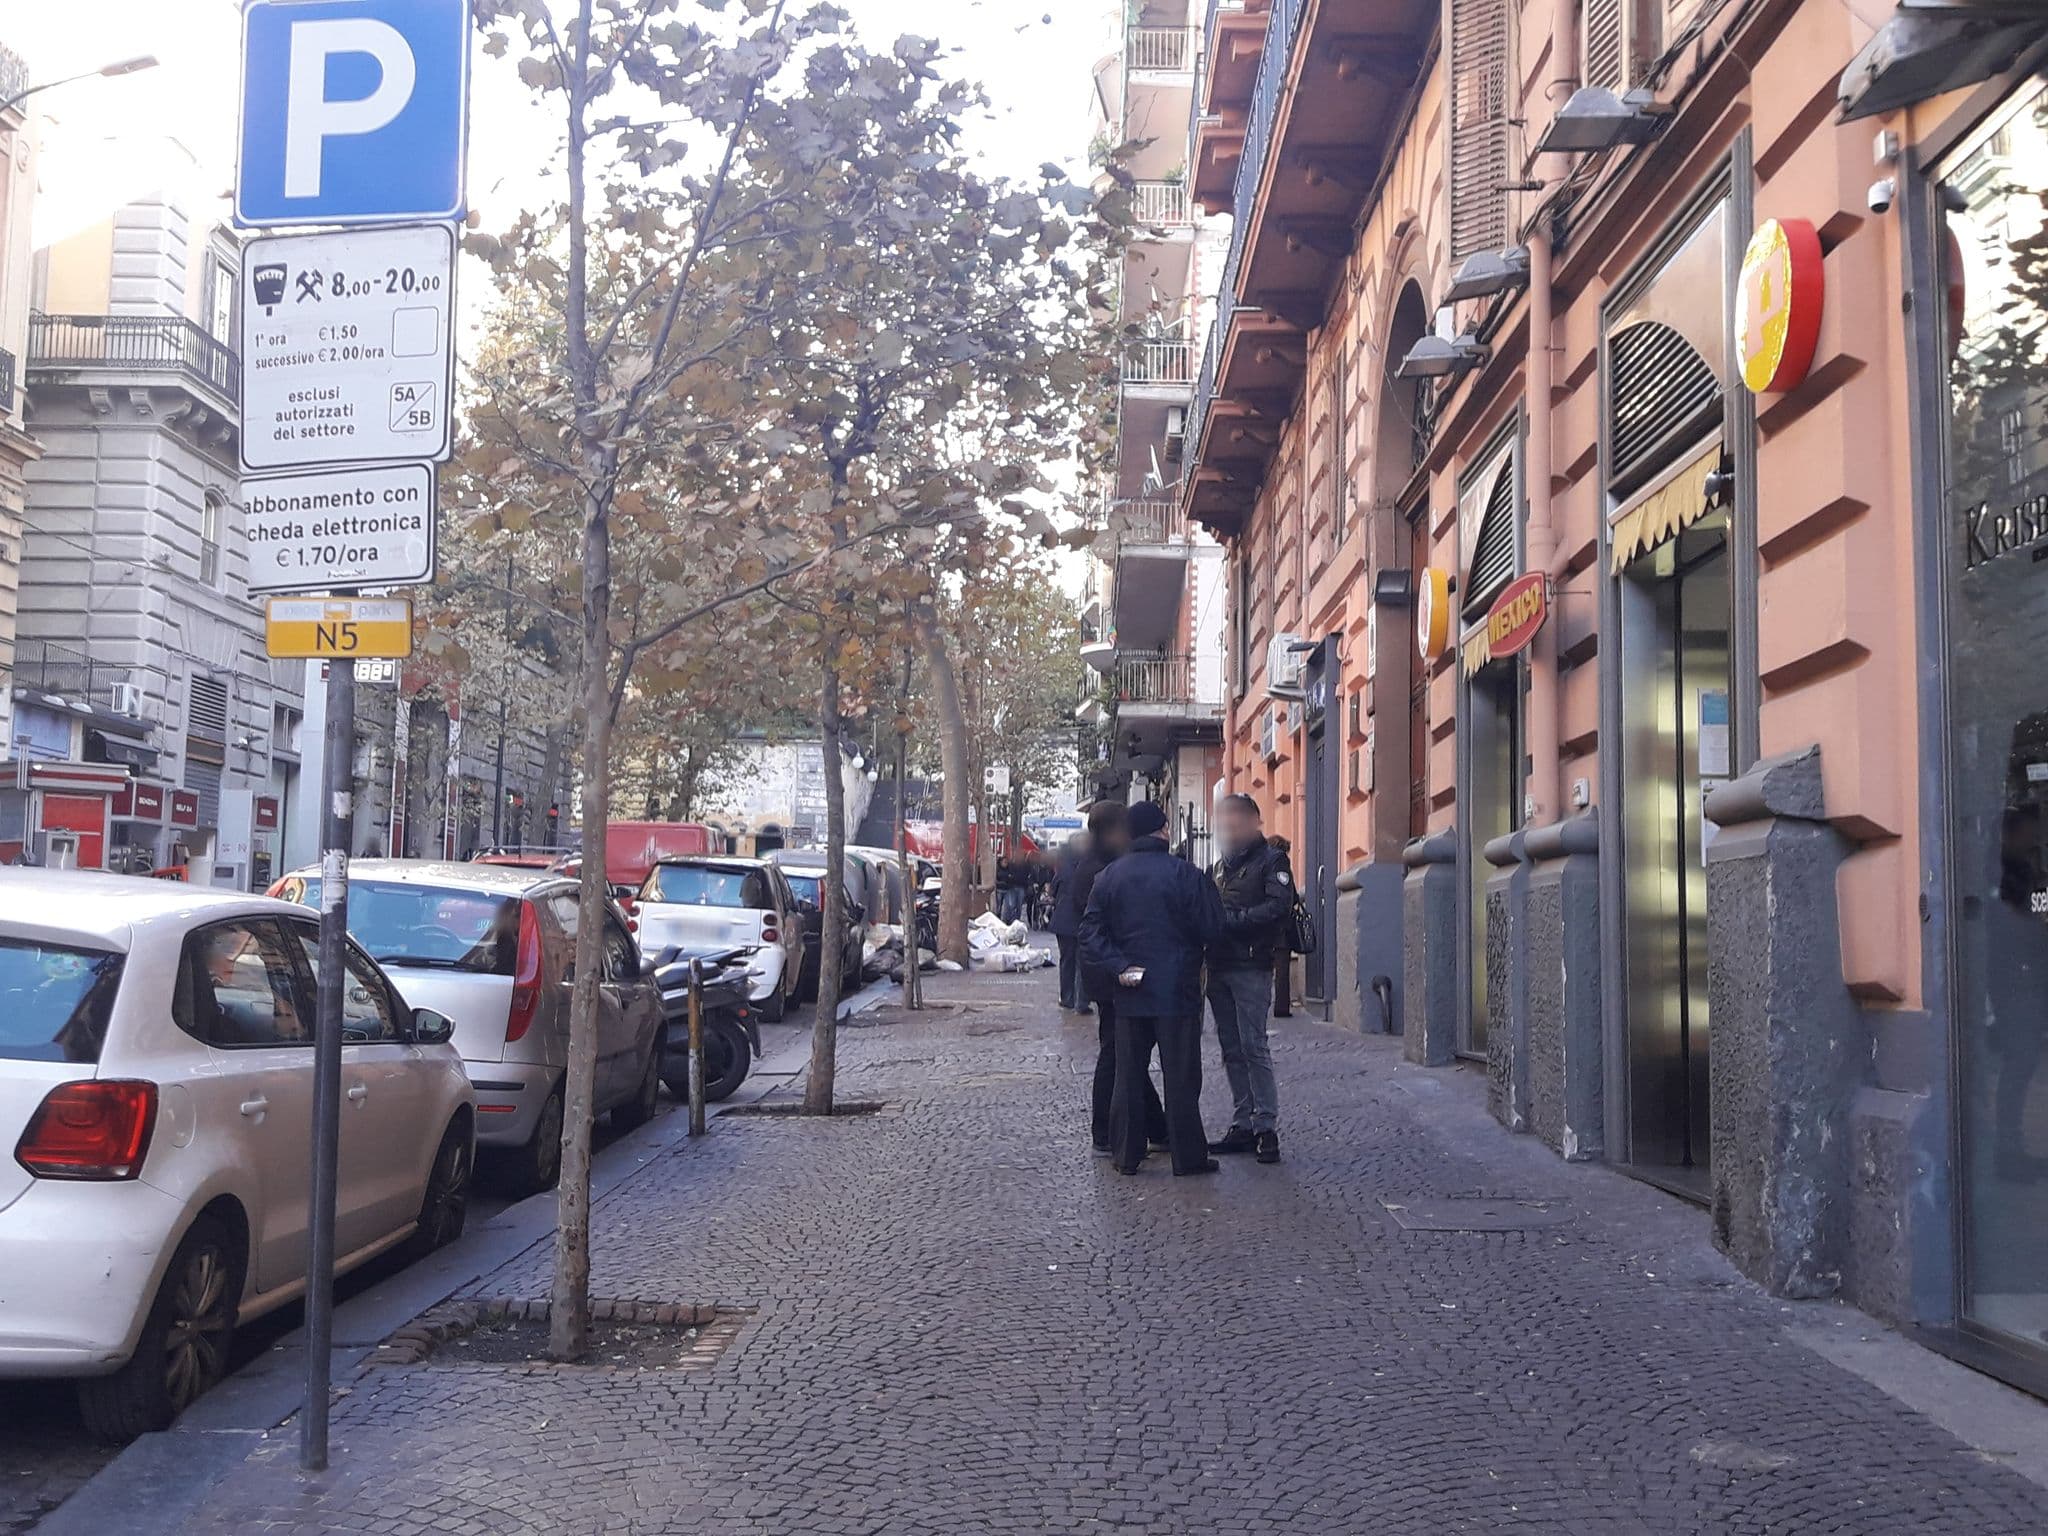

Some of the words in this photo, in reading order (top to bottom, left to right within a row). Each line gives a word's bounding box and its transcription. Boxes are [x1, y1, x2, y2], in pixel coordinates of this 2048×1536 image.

[285, 18, 416, 198] P
[269, 334, 287, 346] ora
[288, 386, 340, 403] esclusi
[394, 386, 416, 402] 5A
[275, 404, 354, 423] autorizzati
[408, 410, 431, 426] 5B
[273, 422, 295, 441] del
[300, 423, 355, 439] settore
[243, 487, 374, 514] abbonamento
[383, 486, 419, 503] con
[312, 513, 421, 537] elettronica
[1488, 581, 1541, 645] MEXICO
[316, 622, 359, 651] N5
